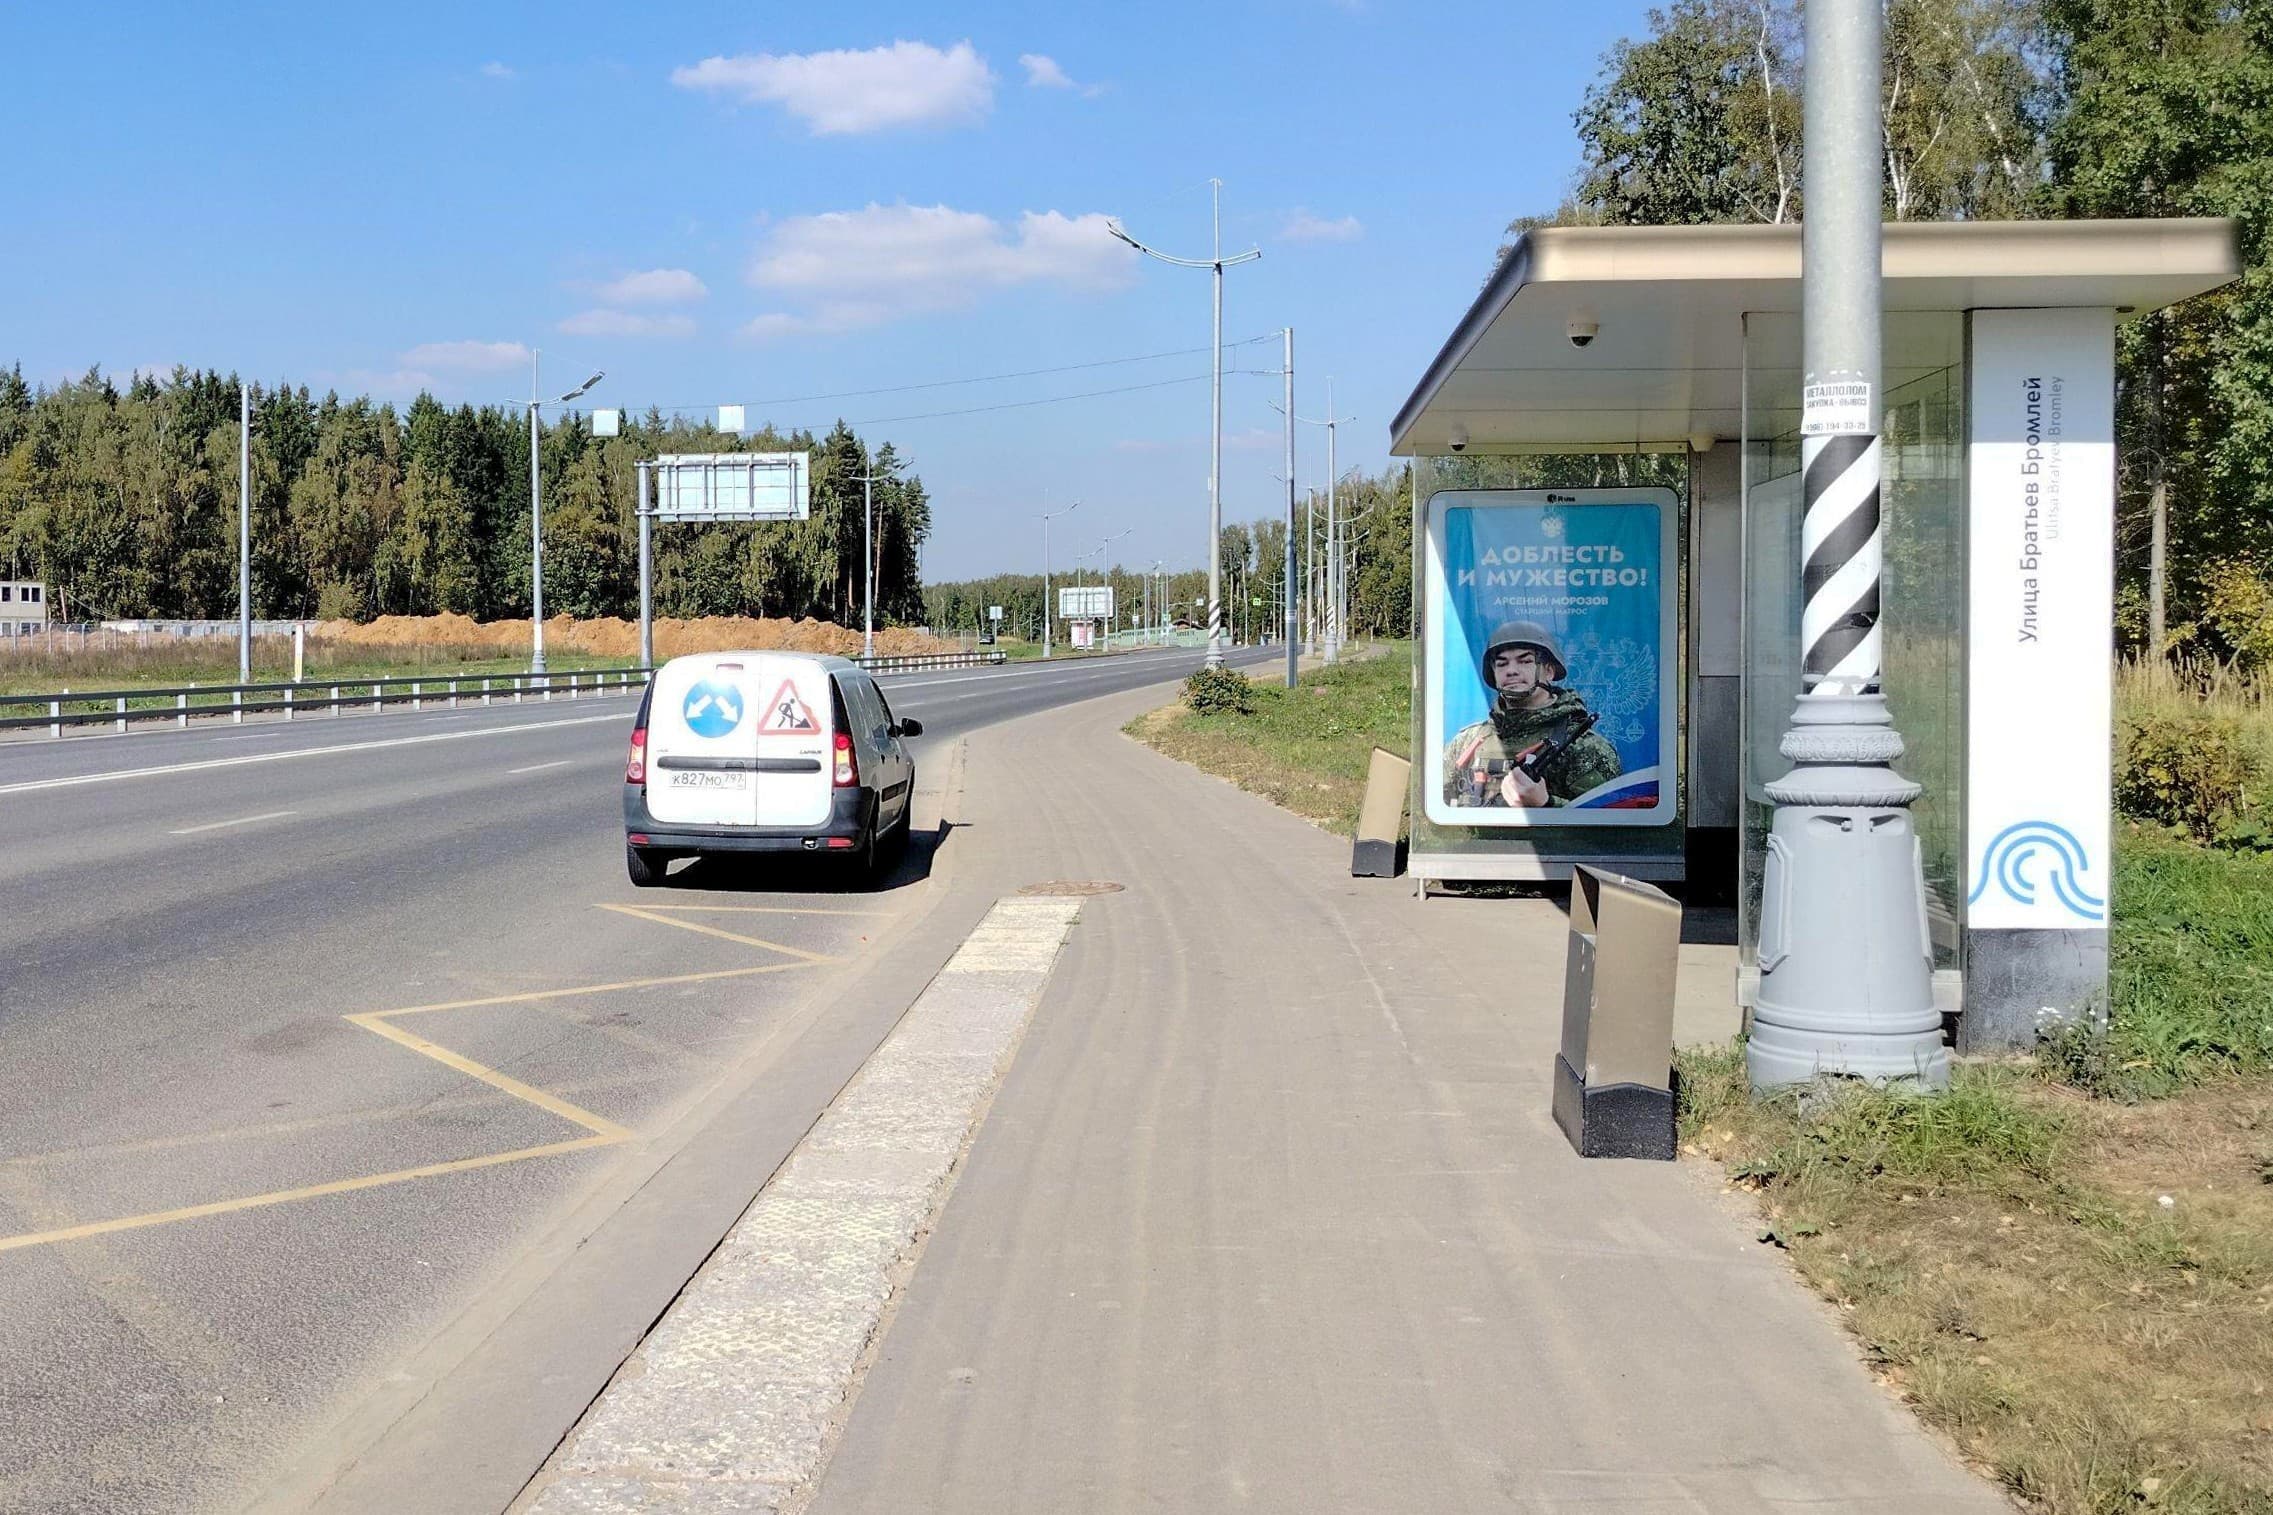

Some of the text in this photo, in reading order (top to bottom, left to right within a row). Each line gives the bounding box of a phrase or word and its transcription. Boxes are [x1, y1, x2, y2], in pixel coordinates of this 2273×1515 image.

[1806, 385, 1867, 398] МЕТАЛЛОЛОМ
[2048, 376, 2065, 435] Bromley
[2018, 376, 2044, 643] Улица Братьев Бромлей
[2045, 498, 2060, 540] Ulitsa
[1481, 546, 1624, 566] ДОБЛЕСТЬ
[1458, 568, 1647, 586] И МУЖЕСТВО!
[1494, 595, 1609, 605] АРСЕНИЙ МОРОЗОВ
[672, 773, 743, 786] К827МО 797
